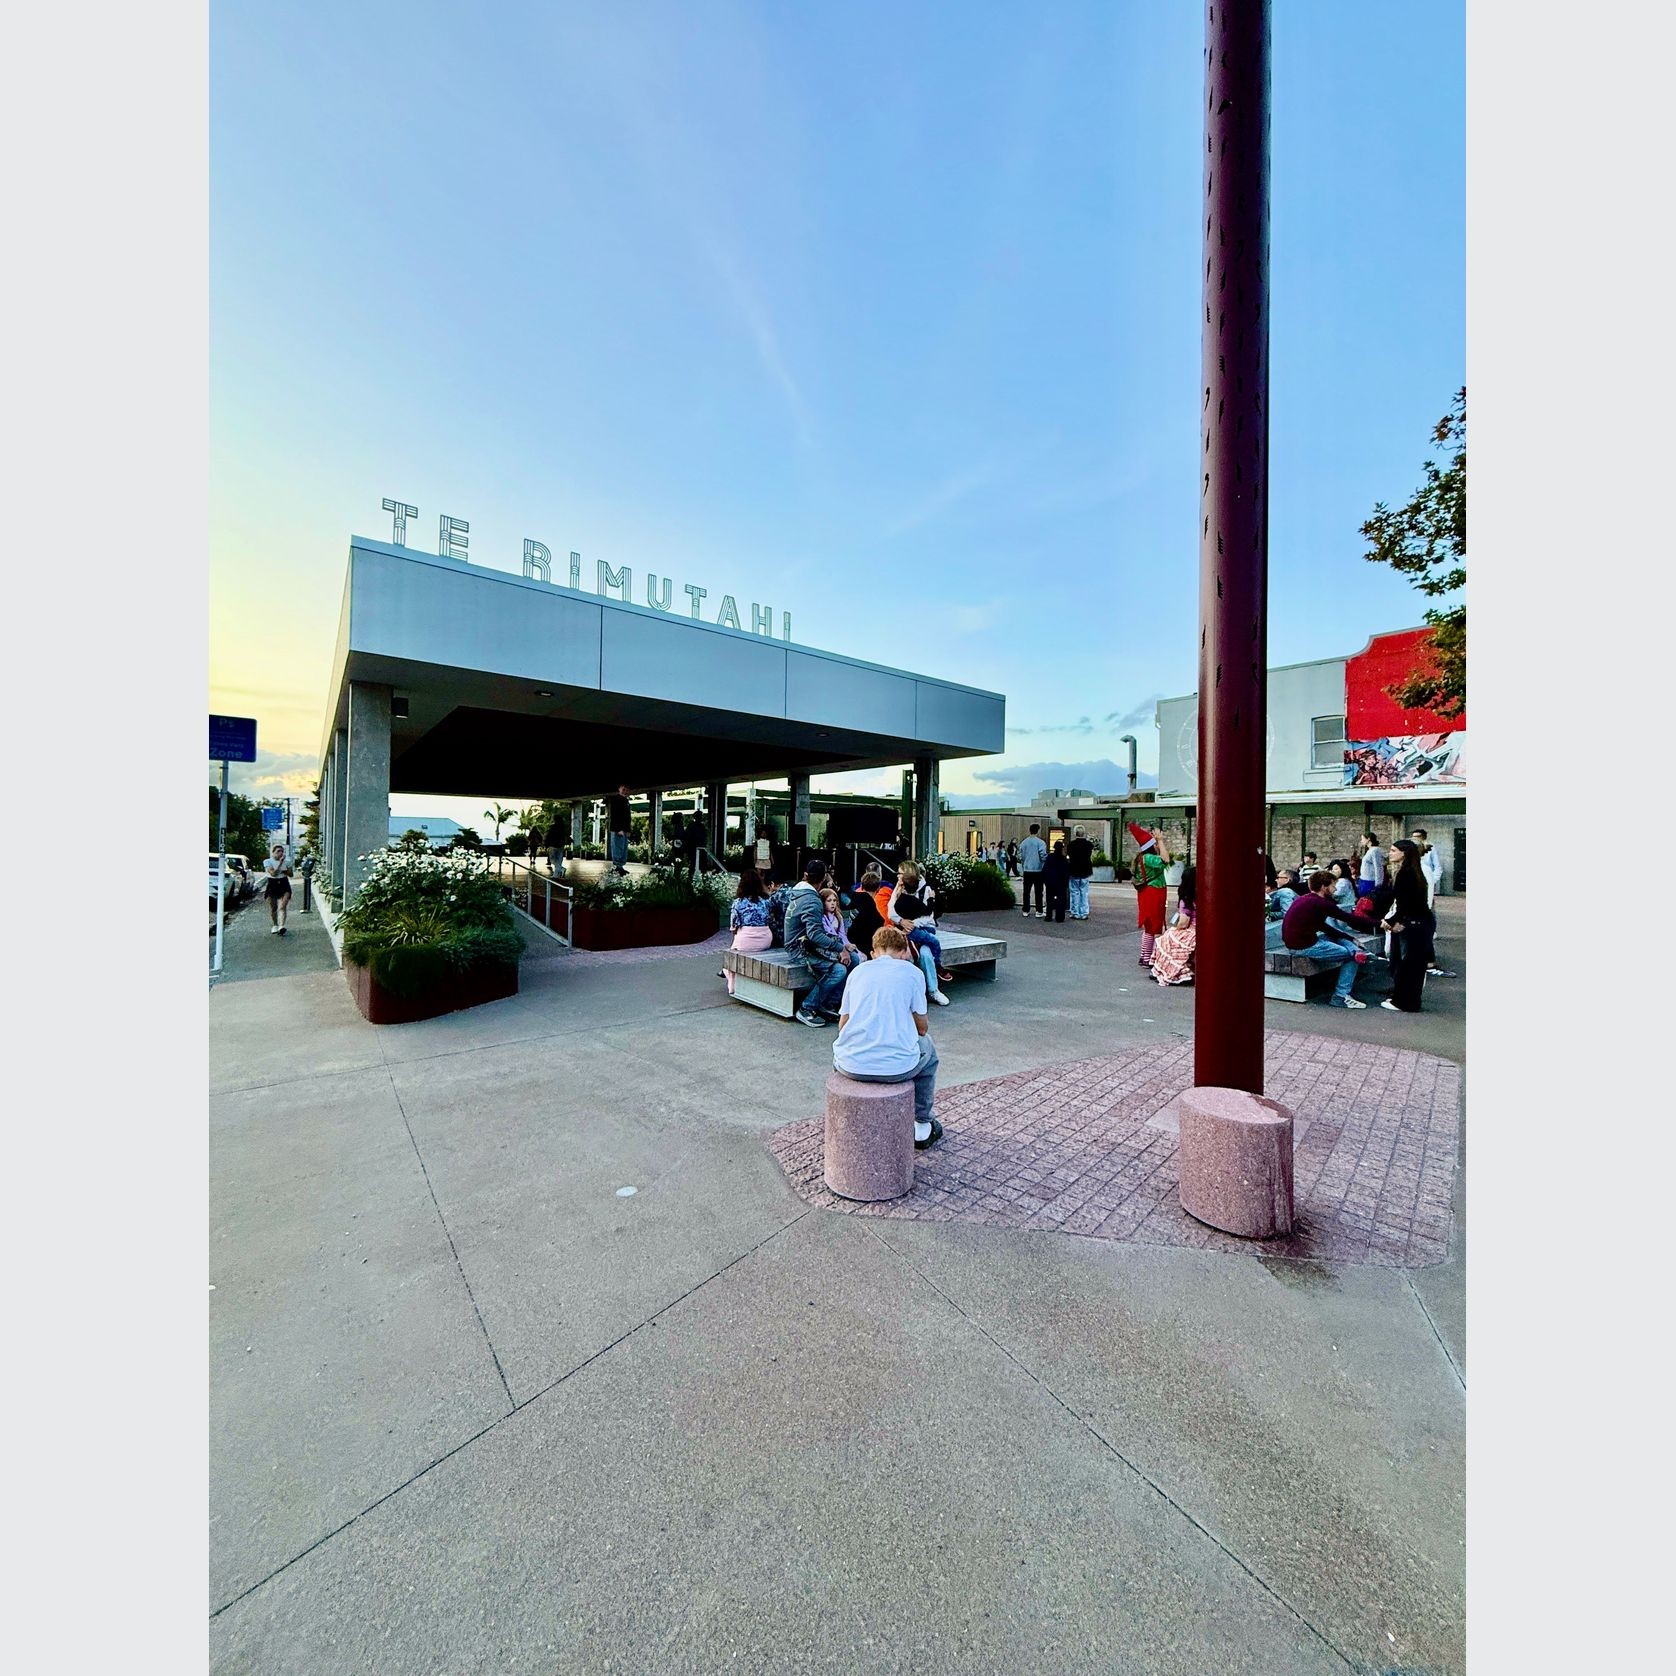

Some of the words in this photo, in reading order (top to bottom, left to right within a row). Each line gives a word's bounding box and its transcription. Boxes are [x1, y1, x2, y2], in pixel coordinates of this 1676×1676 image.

[382, 498, 470, 563] TE
[523, 538, 792, 643] RIMUTAHI
[209, 747, 243, 759] Zone
